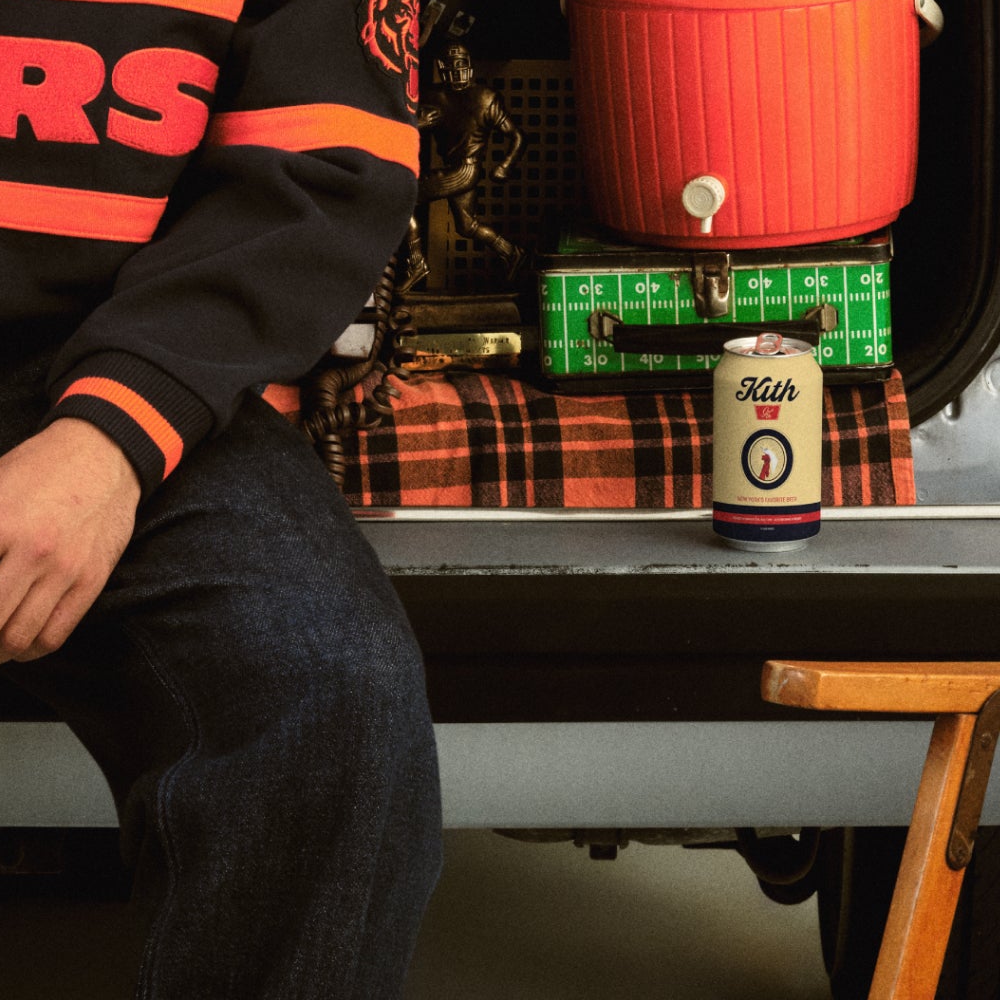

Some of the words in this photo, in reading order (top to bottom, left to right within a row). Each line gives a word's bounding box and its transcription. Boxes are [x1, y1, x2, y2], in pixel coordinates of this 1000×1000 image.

[748, 277, 773, 290] 40
[804, 275, 829, 288] 30
[860, 272, 884, 285] 20
[579, 283, 604, 296] 30
[635, 281, 660, 294] 40
[864, 343, 887, 357] 20
[583, 354, 608, 367] 30
[639, 354, 664, 364] 40
[735, 376, 801, 403] Kith
